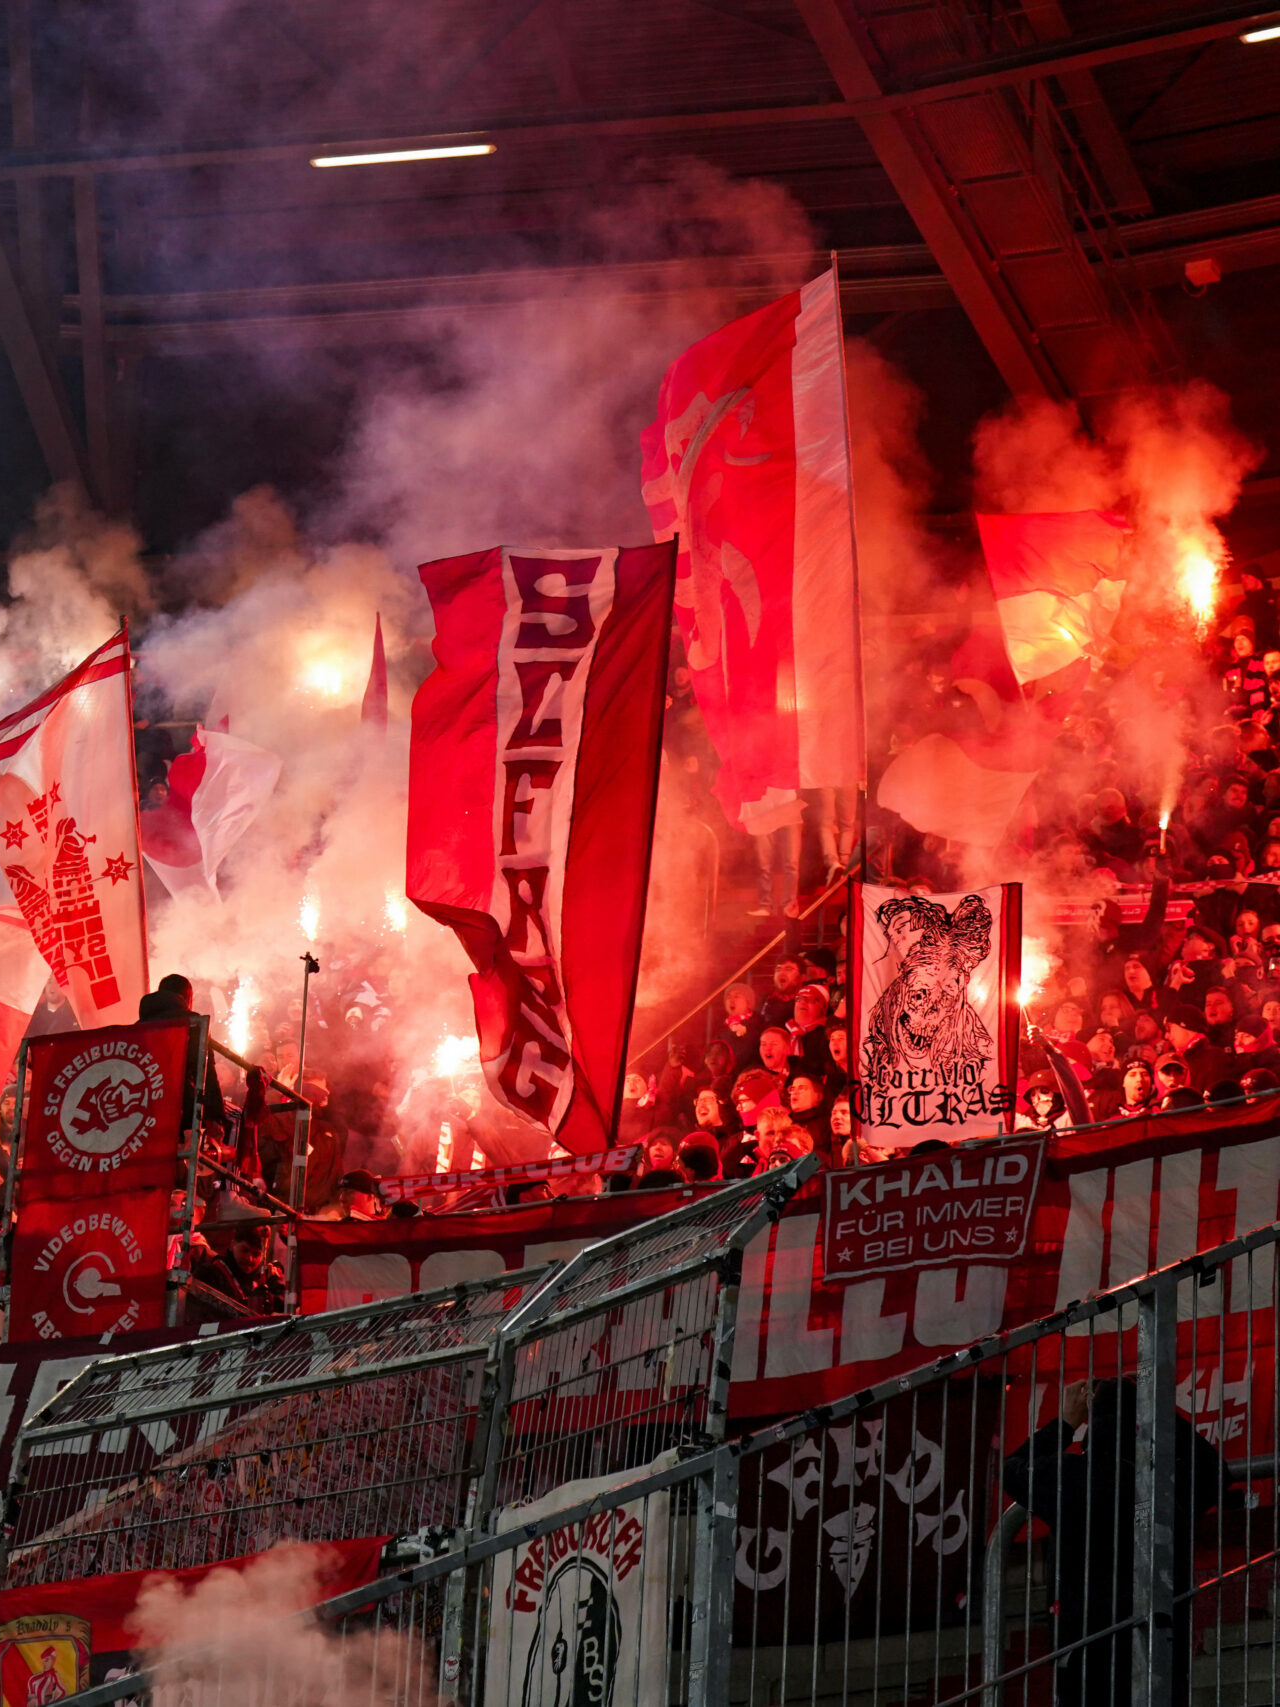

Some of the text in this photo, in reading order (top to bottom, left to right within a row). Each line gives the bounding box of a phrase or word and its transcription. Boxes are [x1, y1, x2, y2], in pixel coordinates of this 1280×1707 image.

[44, 1041, 163, 1116] SC FREIBURG-FANS
[849, 1079, 1015, 1129] ULTRAS
[46, 1116, 156, 1173] GEGEN RECHTS
[839, 1154, 1030, 1211] KHALID
[33, 1213, 142, 1272] VIDEOBEWEIS
[836, 1196, 1025, 1240] FÜR IMMER
[863, 1225, 996, 1263] BEI UNS
